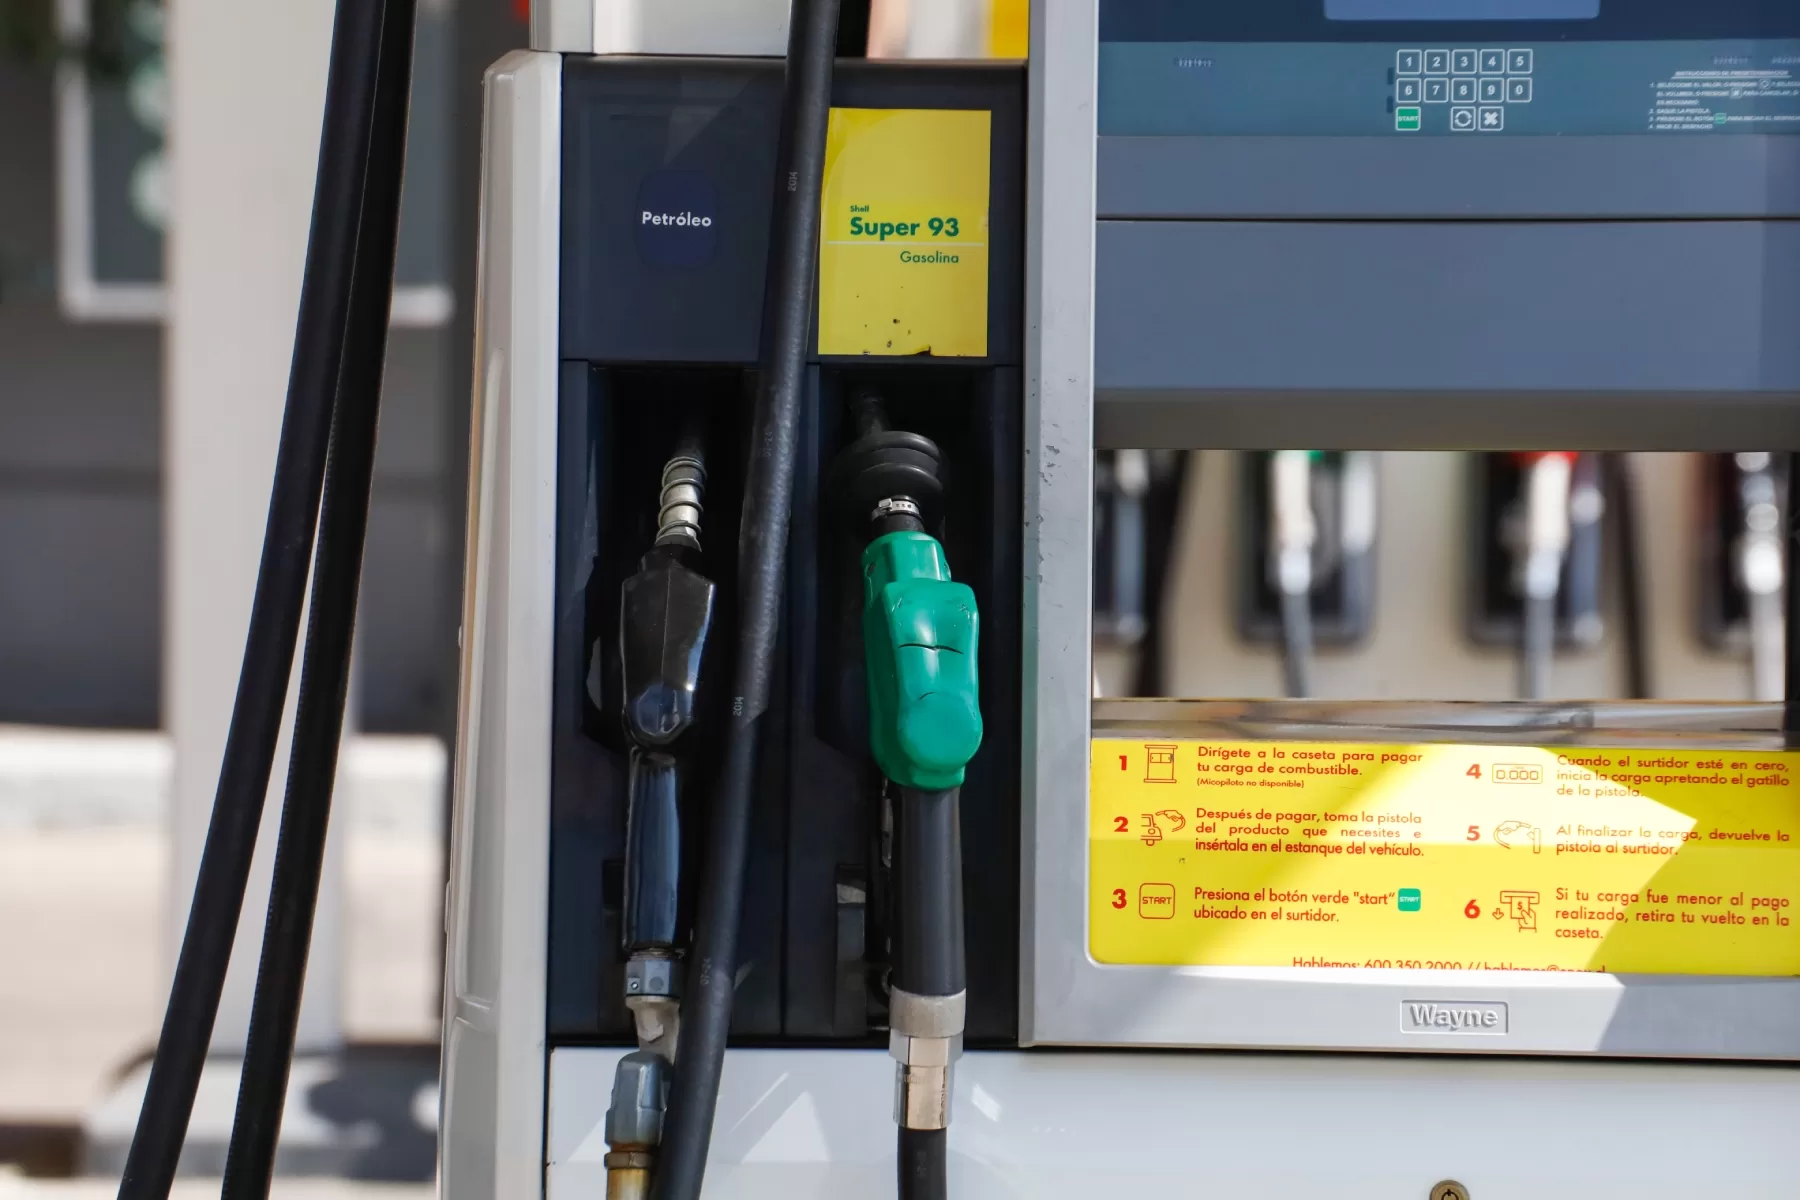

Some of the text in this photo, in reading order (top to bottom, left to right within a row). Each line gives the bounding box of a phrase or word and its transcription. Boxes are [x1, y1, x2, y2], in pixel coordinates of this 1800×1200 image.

[1405, 56, 1524, 67] 1 2 3 4 5
[1404, 84, 1524, 96] 6 7 8 9 0
[788, 171, 798, 192] 2014
[850, 205, 870, 213] Shell
[642, 211, 712, 228] Petróleo
[850, 217, 959, 241] Super 93
[900, 250, 959, 264] Gasolina
[732, 696, 744, 717] 2014
[1119, 755, 1127, 771] 1
[1198, 746, 1251, 759] Dirígete
[1273, 748, 1285, 758] la
[1292, 751, 1335, 759] caseta
[1343, 753, 1374, 763] para
[1381, 754, 1422, 764] pagar
[1558, 754, 1611, 767] Cuando
[1618, 756, 1630, 767] el
[1637, 757, 1689, 768] surtidor
[1696, 759, 1723, 769] esté
[1754, 763, 1788, 772] cero,
[1197, 762, 1362, 775] tu carga de combustible.
[1466, 764, 1481, 779] 4
[1259, 779, 1304, 788] disponible)
[1557, 769, 1789, 788] inicia la carga apretando el gatillo
[1557, 785, 1645, 798] de la pistola.
[1114, 816, 1128, 832] 2
[1197, 808, 1421, 825] Después de pagar, toma la pistola
[1196, 822, 1215, 833] del
[1229, 823, 1289, 839] producto
[1303, 829, 1327, 838] que
[1341, 828, 1400, 837] necesites
[1467, 826, 1480, 841] 5
[1557, 825, 1789, 842] Al finalizar la carga, devuelve la
[1196, 838, 1424, 857] insértala en el estanque del vehículo.
[1556, 843, 1679, 855] pistola al surtidor.
[1112, 889, 1127, 909] 3
[1142, 896, 1171, 904] START
[1195, 887, 1249, 901] Presiona
[1254, 888, 1265, 901] el
[1269, 888, 1307, 902] botón
[1312, 890, 1349, 904] verde
[1556, 887, 1789, 910] Si tu carga fue menor al pago
[1194, 905, 1339, 922] ubicado en el surtidor.
[1464, 899, 1480, 919] 6
[1556, 906, 1789, 926] realizado, retira tu vuelto en la
[1555, 928, 1603, 938] caseta.
[1410, 1004, 1498, 1032] Wayne
